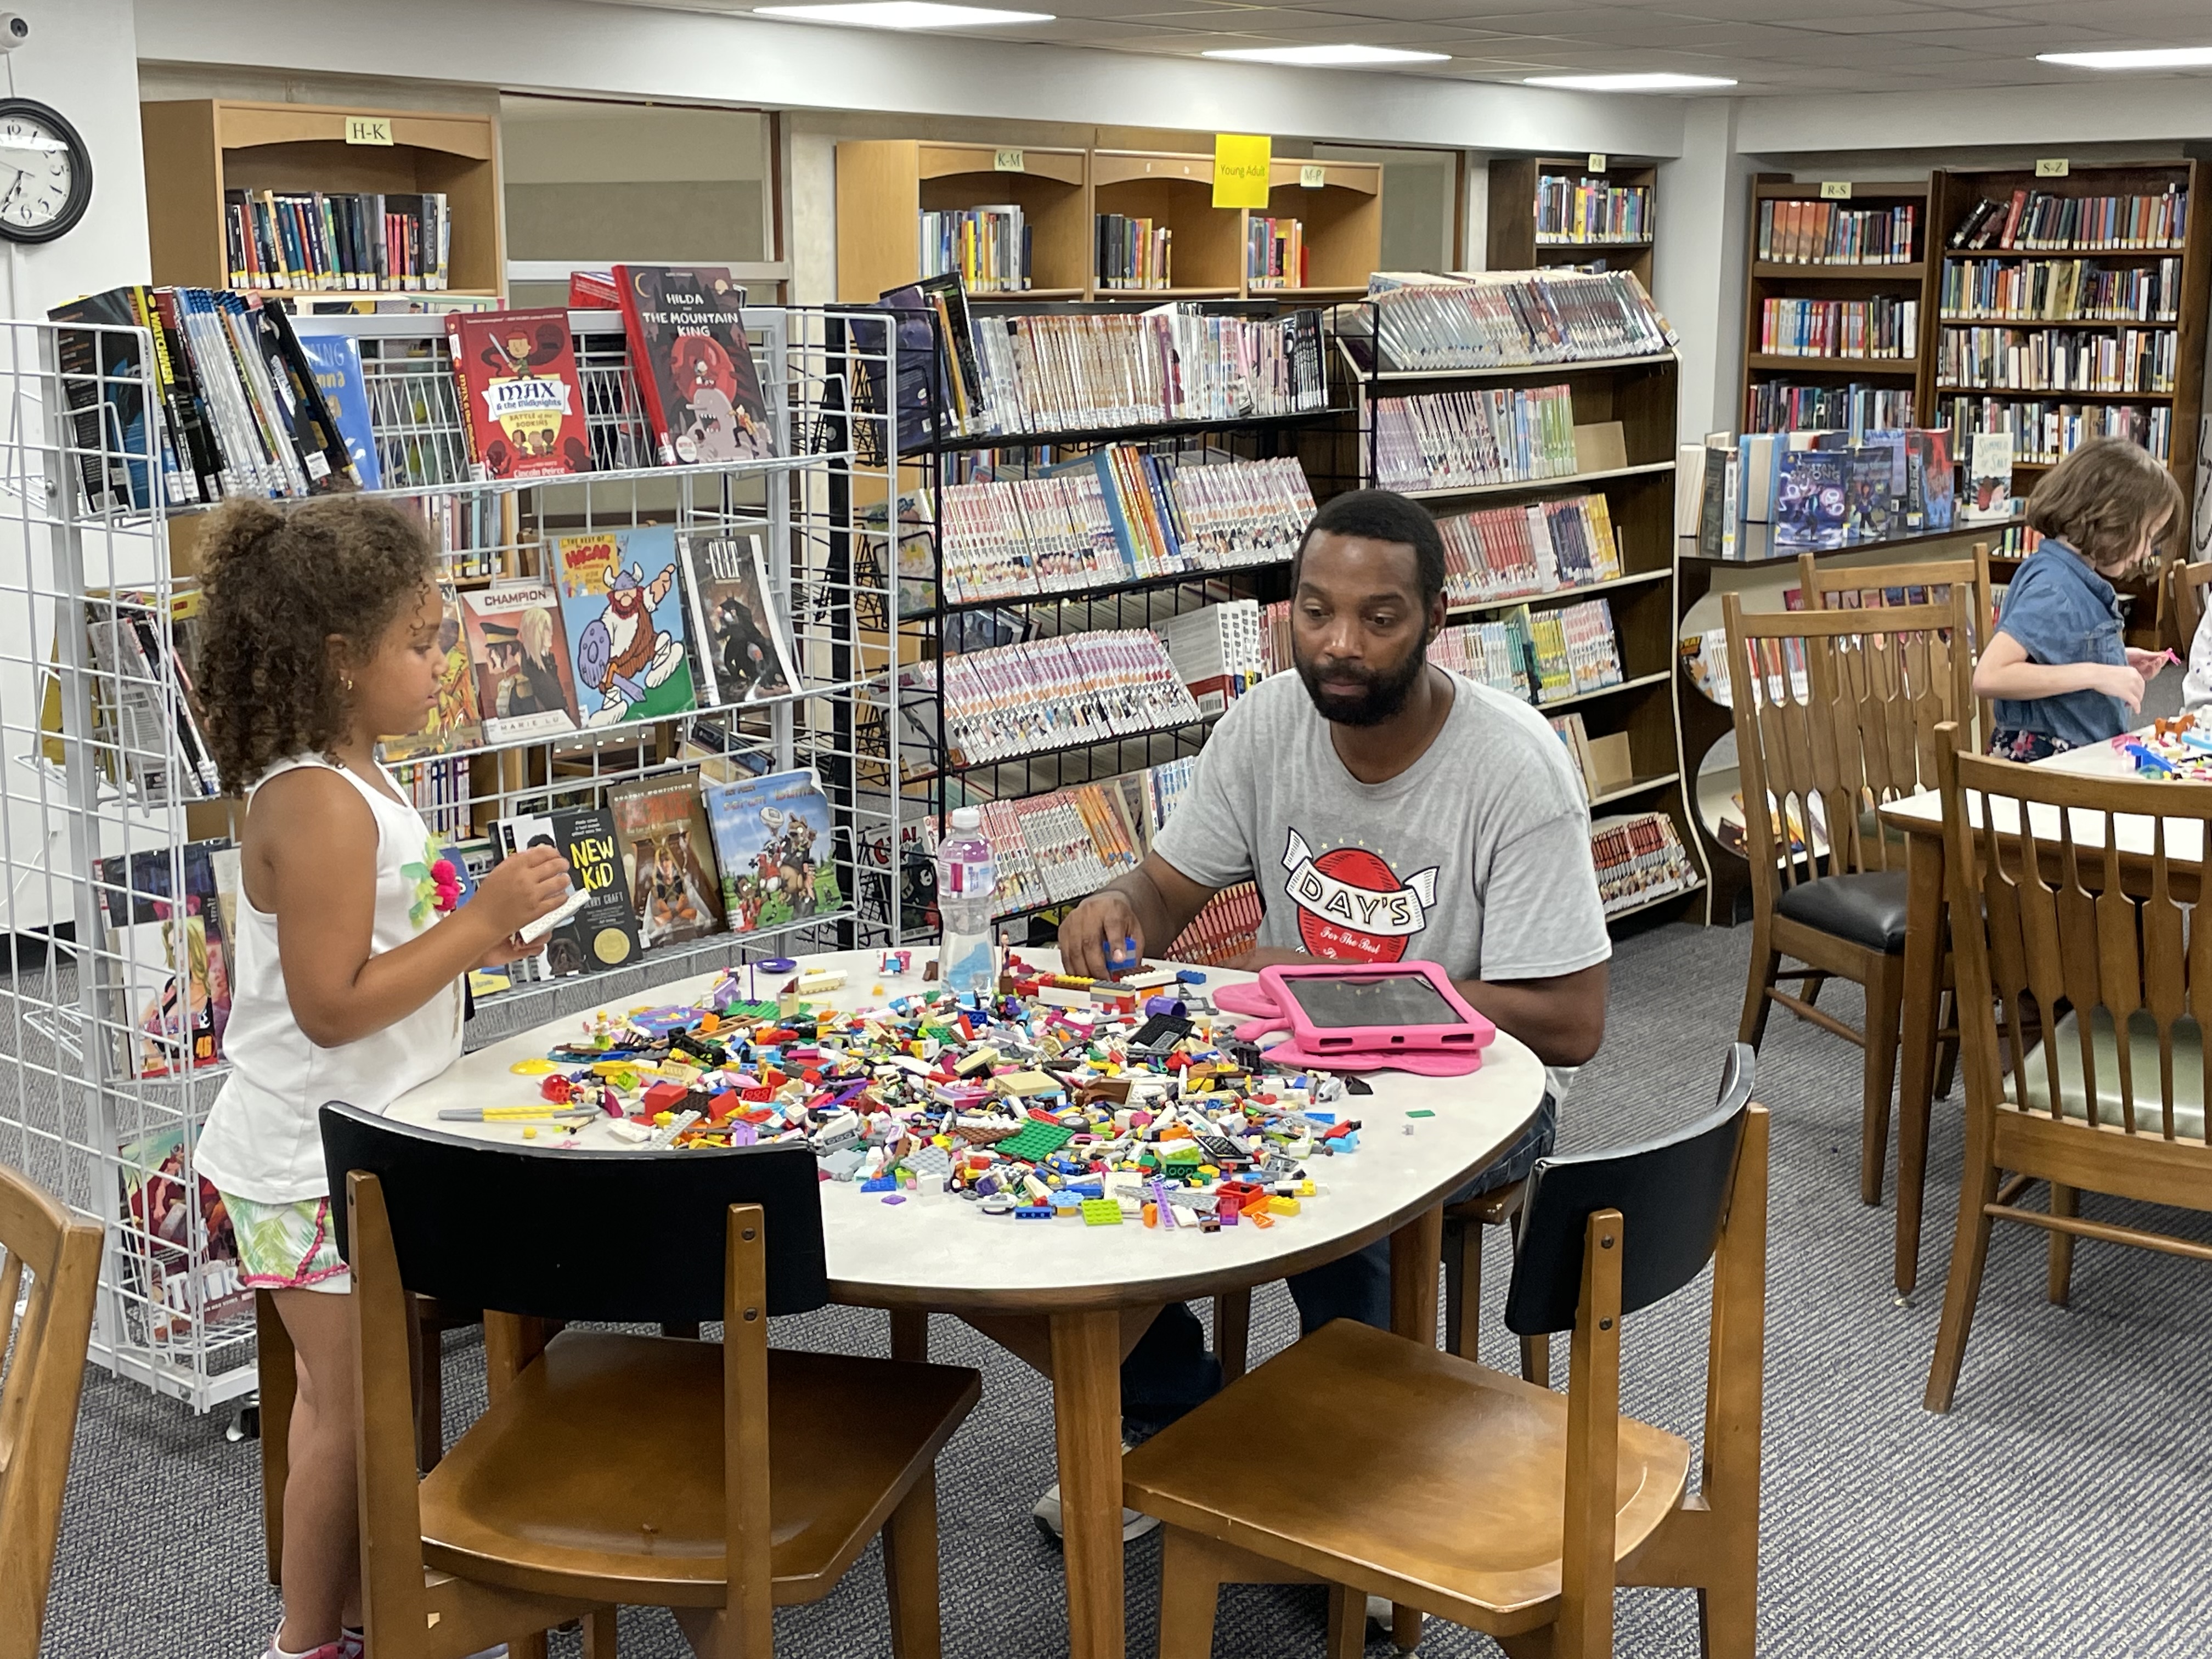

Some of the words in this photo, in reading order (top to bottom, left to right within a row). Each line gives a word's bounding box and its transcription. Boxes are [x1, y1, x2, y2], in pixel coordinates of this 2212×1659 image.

[352, 123, 386, 139] H-K
[998, 150, 1020, 168] K-M
[1220, 165, 1244, 178] Young
[1246, 165, 1265, 177] Adult
[1304, 168, 1322, 182] M-P
[2043, 162, 2062, 173] S-Z
[1828, 185, 1846, 195] R-S
[665, 294, 704, 304] HILDA
[642, 312, 668, 324] THE
[670, 313, 738, 324] MOUNTAIN
[676, 325, 711, 337] KING
[149, 311, 174, 385] WATCHMEN
[498, 382, 556, 402] MAX
[514, 468, 541, 478] Lincoln
[484, 589, 547, 606] CHAMPION
[500, 720, 538, 731] MARIE
[545, 716, 560, 725] LU
[569, 835, 614, 869] NEW
[603, 891, 624, 905] CRAFT
[1299, 870, 1412, 927] DAY'S
[1320, 926, 1339, 941] For
[1339, 932, 1358, 947] The
[1358, 938, 1381, 955] Best
[195, 1035, 213, 1059] 46
